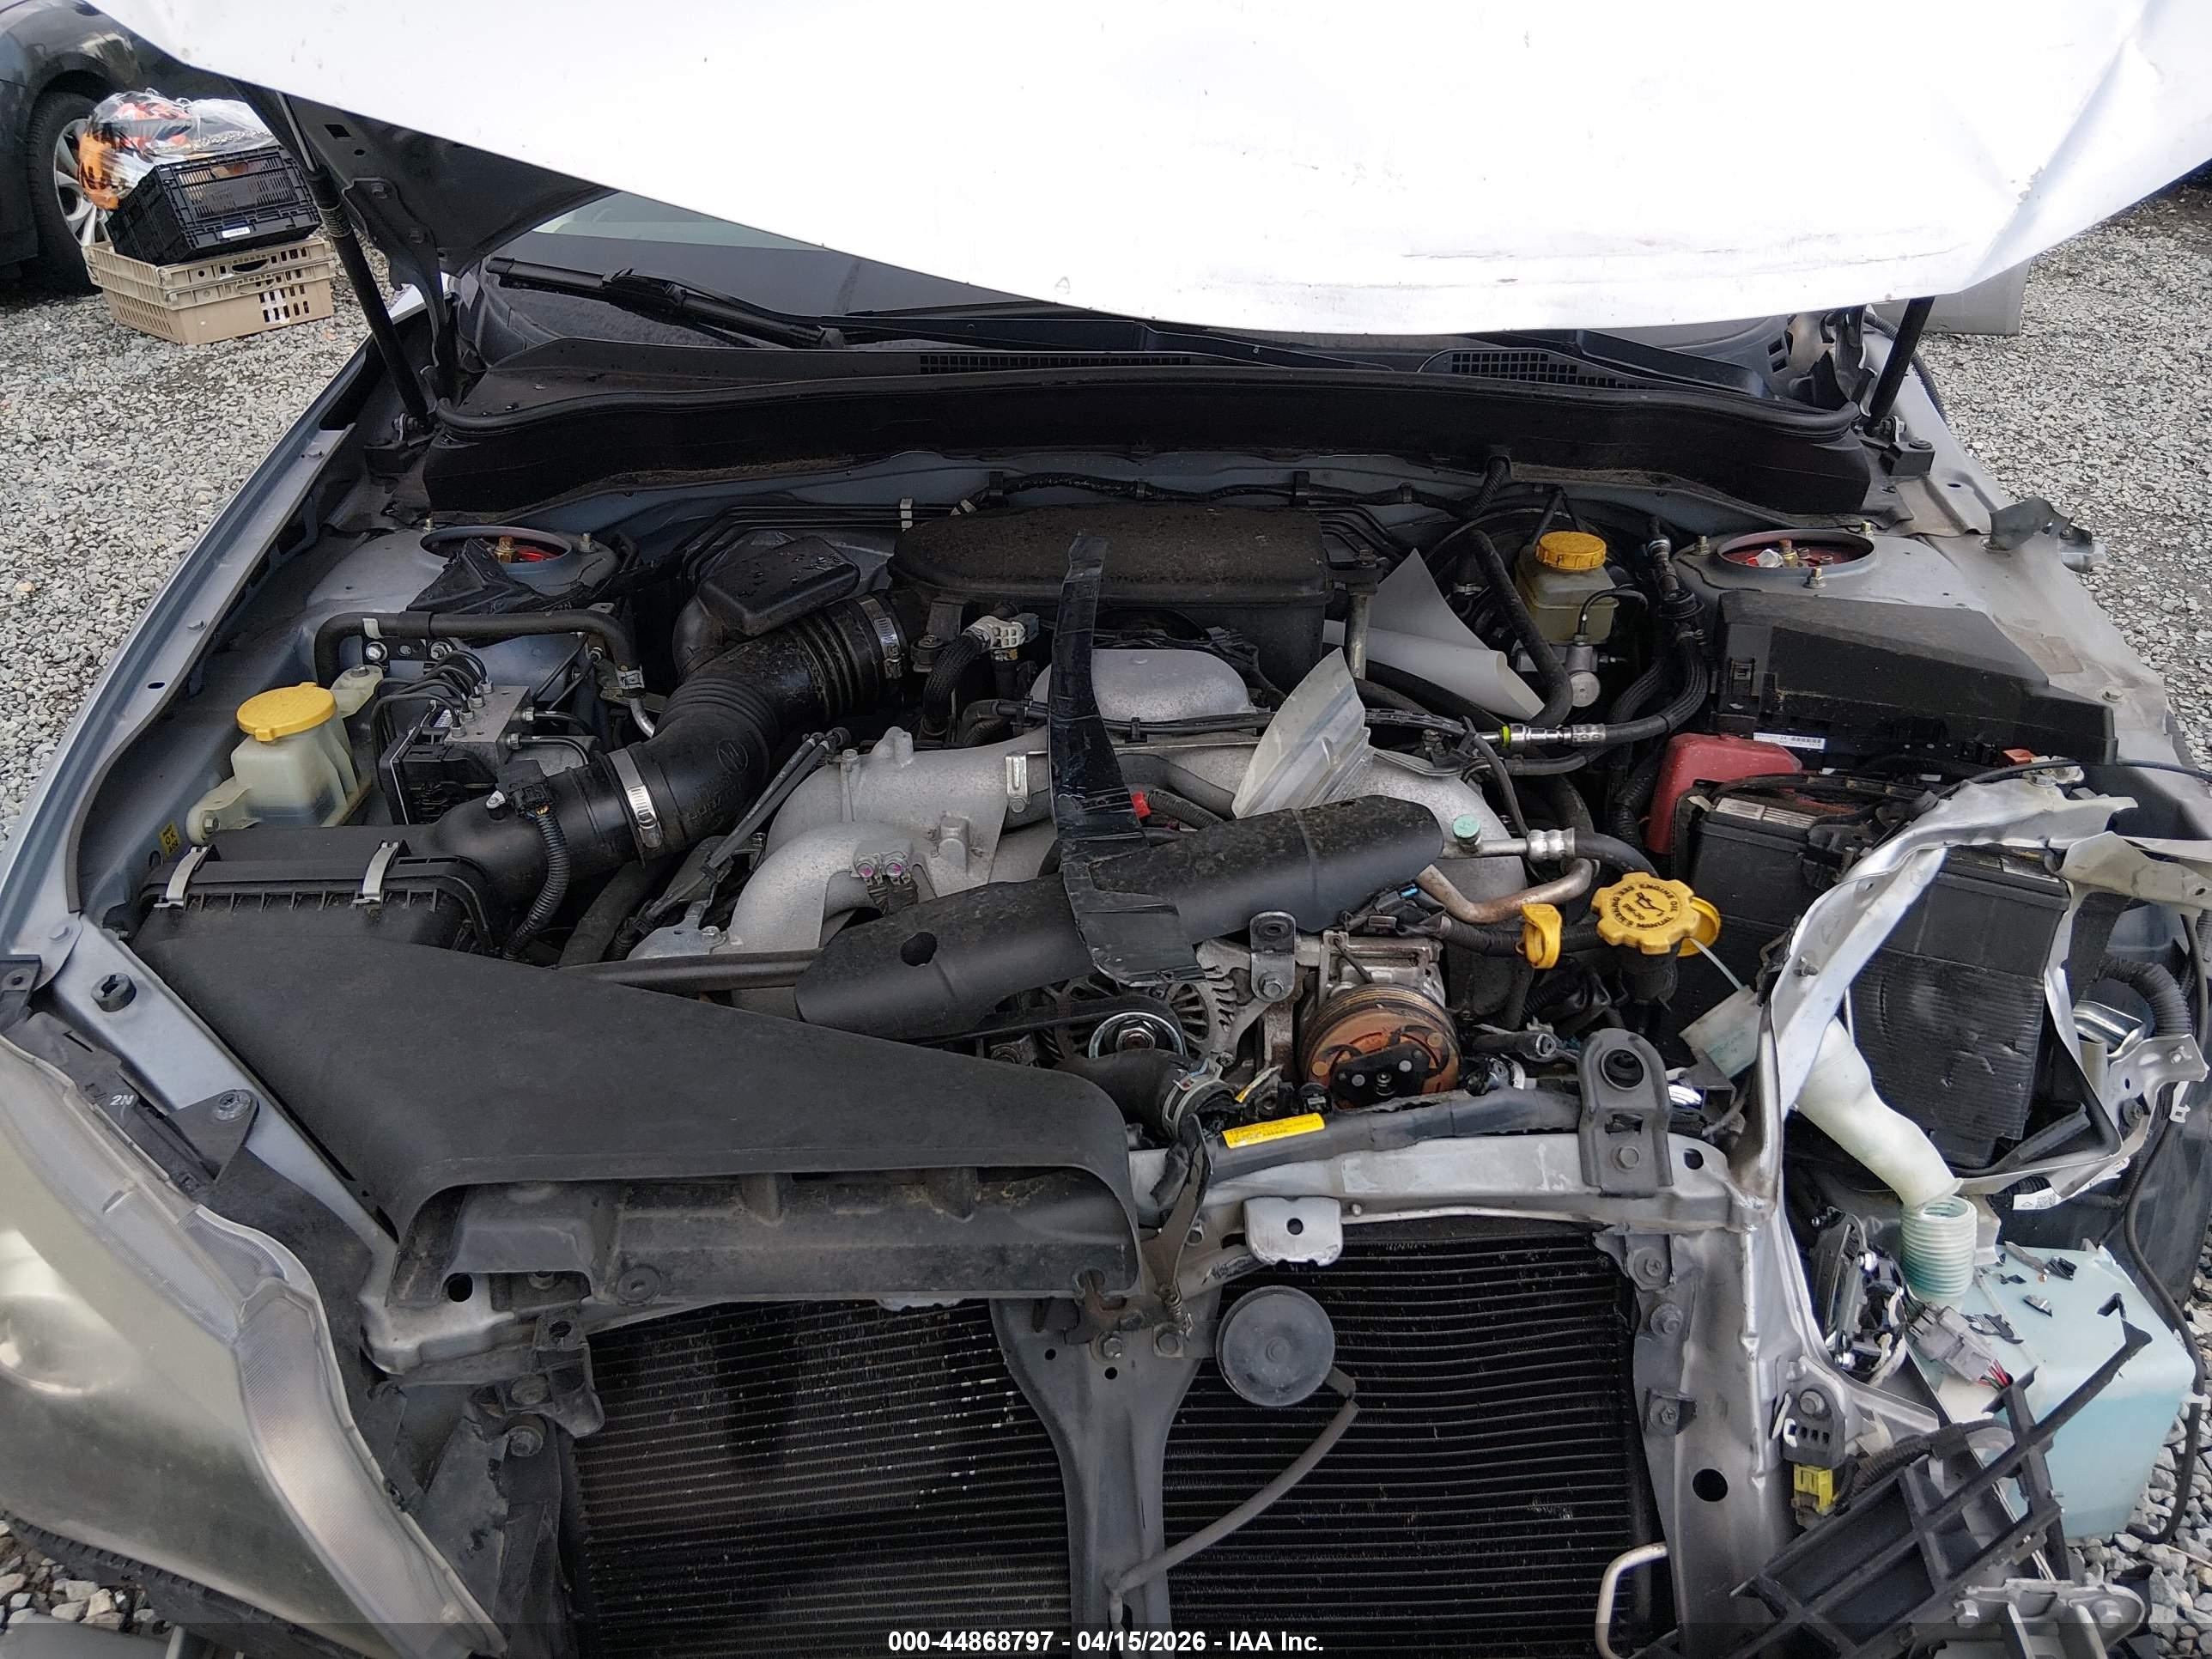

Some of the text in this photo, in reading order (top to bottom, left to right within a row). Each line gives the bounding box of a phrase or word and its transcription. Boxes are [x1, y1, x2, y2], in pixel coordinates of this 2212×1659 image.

[1618, 884, 1635, 896] SEE
[1636, 916, 1674, 928] MANUAL
[1639, 883, 1675, 900] ENGINE
